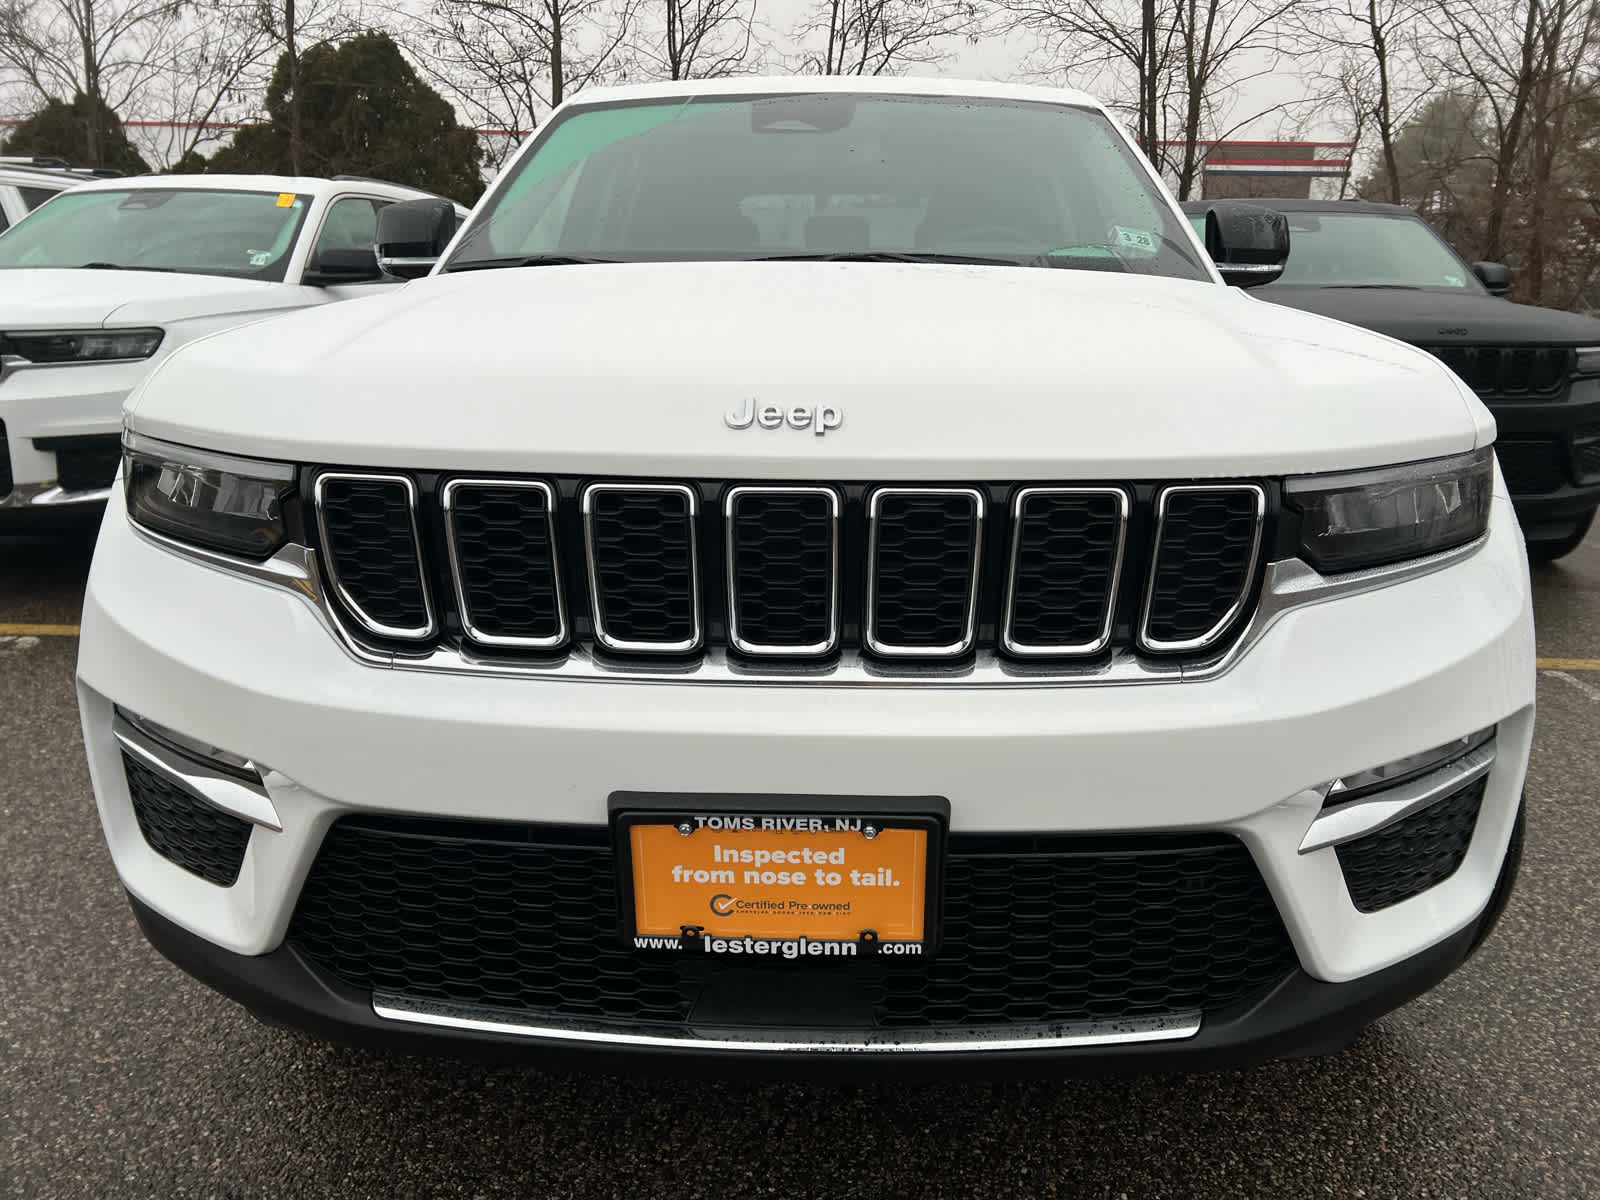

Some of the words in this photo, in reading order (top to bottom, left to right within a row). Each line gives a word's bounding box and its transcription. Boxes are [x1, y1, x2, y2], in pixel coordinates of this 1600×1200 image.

[723, 397, 844, 437] Jeep
[694, 816, 756, 831] TOMS
[761, 818, 829, 833] RIVER,
[835, 819, 862, 832] NJ
[713, 845, 845, 868] Inspected
[671, 865, 736, 885] from
[743, 870, 807, 886] nose
[814, 869, 842, 886] to
[849, 867, 901, 887] tail.
[735, 900, 785, 910] Certified
[633, 937, 683, 950] www.
[704, 935, 857, 959] lesterglenn
[877, 942, 922, 955] .com
